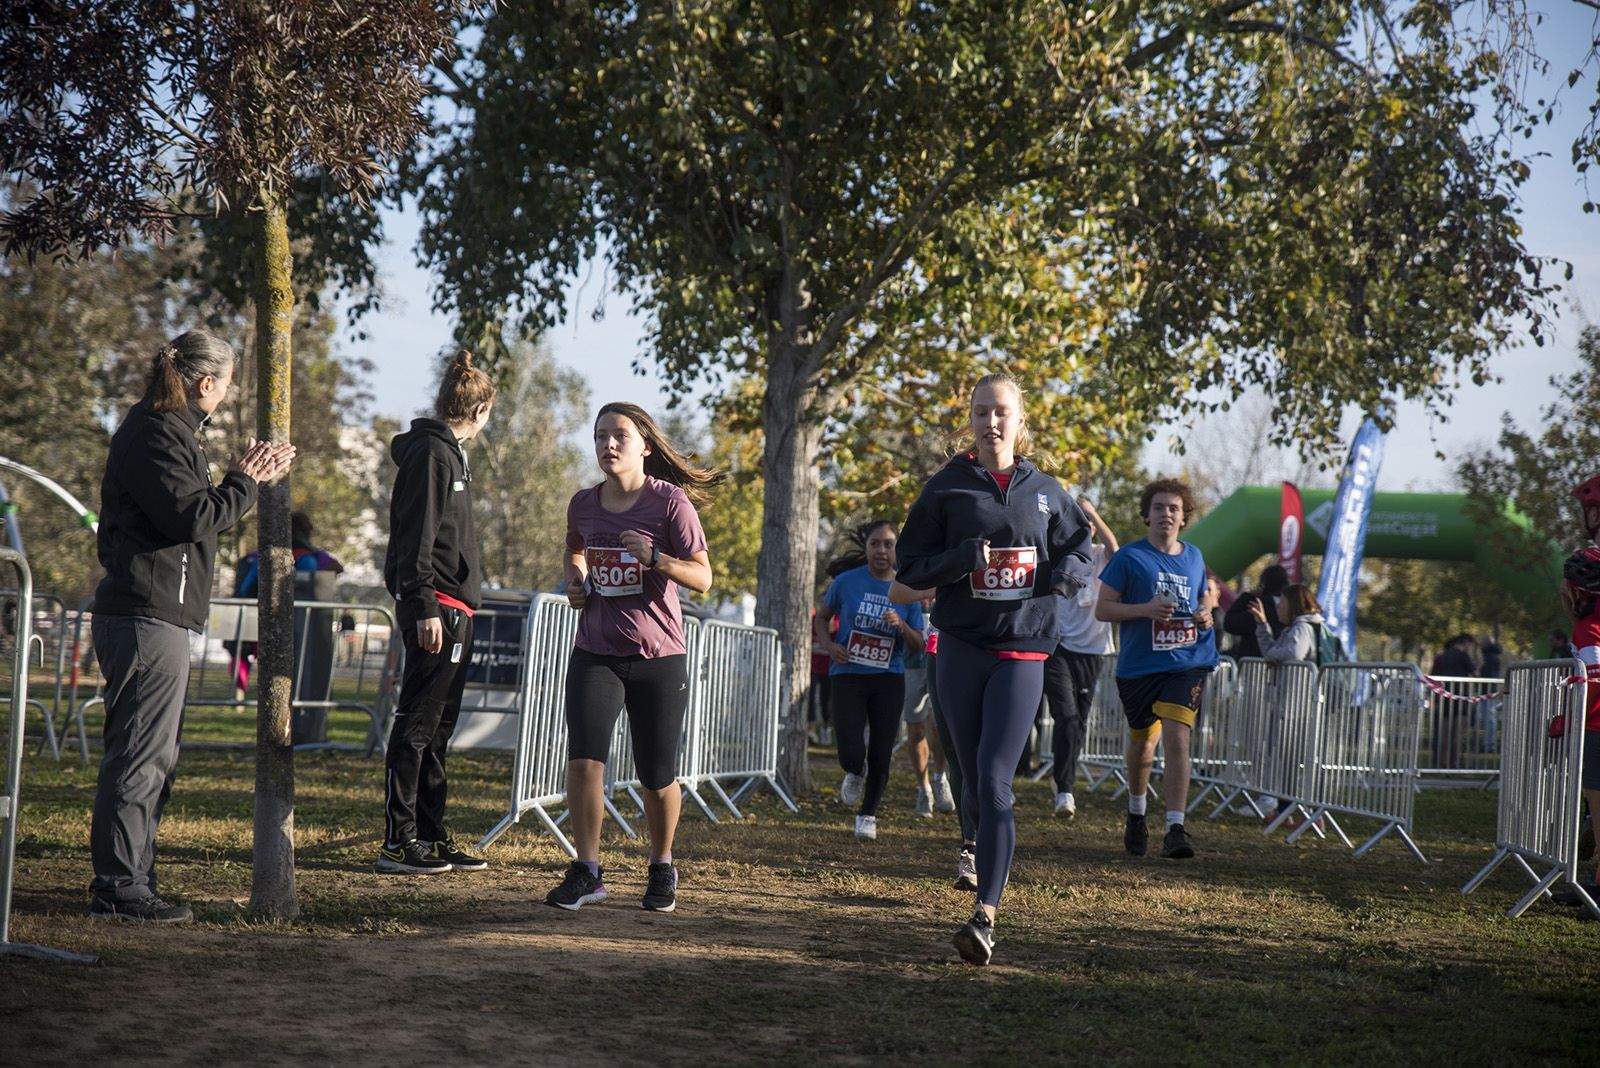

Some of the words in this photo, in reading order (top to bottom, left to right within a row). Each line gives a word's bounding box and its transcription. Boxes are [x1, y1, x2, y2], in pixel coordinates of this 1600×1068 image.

[983, 566, 1027, 589] 680
[1155, 624, 1195, 643] 4481
[850, 642, 889, 661] 4489
